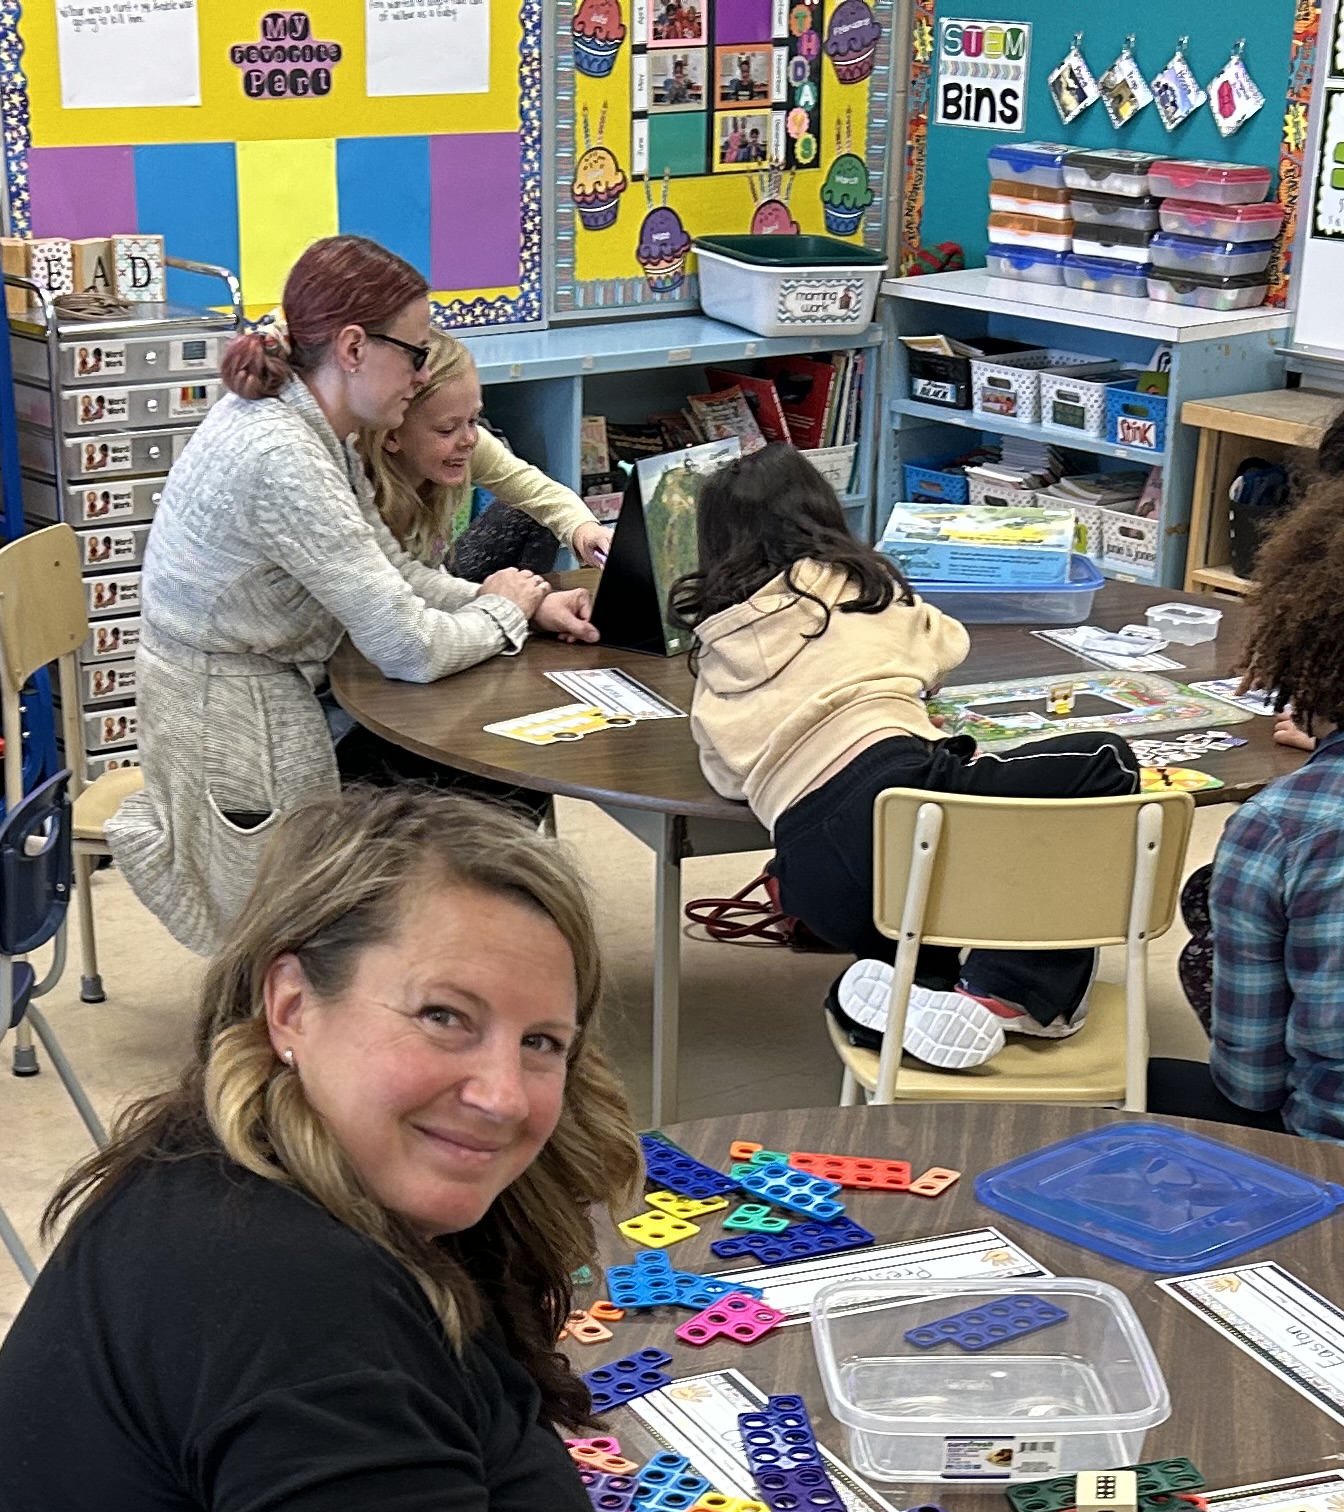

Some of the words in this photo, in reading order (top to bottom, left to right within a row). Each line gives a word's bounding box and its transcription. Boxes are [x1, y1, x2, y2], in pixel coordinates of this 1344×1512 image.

[263, 14, 309, 40] My
[232, 44, 342, 63] Favorite
[943, 24, 1026, 60] STEM
[246, 69, 331, 96] Part
[942, 82, 1019, 125] Bins
